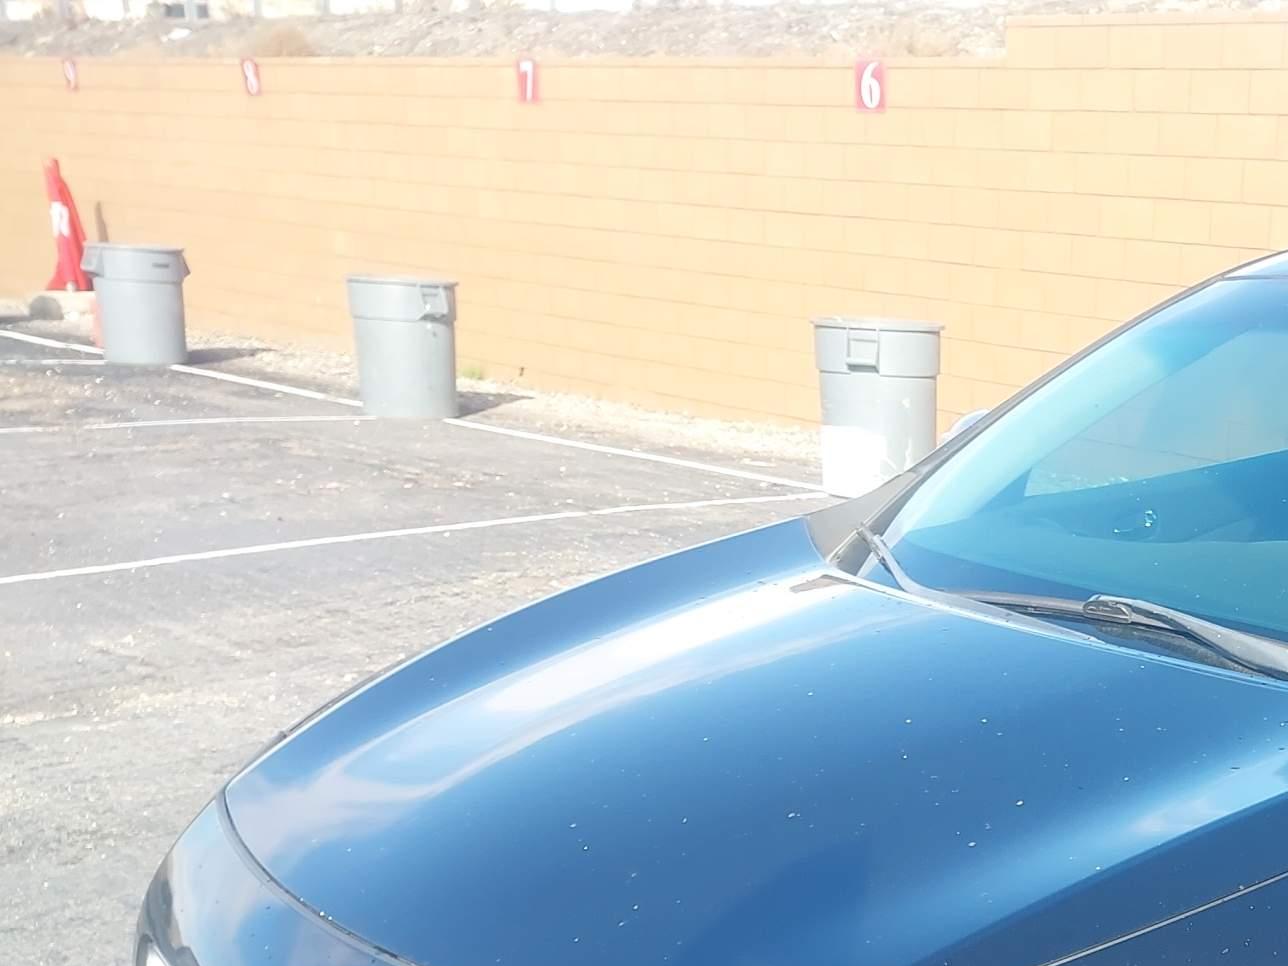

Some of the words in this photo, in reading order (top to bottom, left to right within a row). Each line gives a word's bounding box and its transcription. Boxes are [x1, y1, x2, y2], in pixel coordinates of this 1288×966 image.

[243, 60, 258, 94] 8
[519, 61, 533, 101] 7
[861, 61, 880, 109] 6
